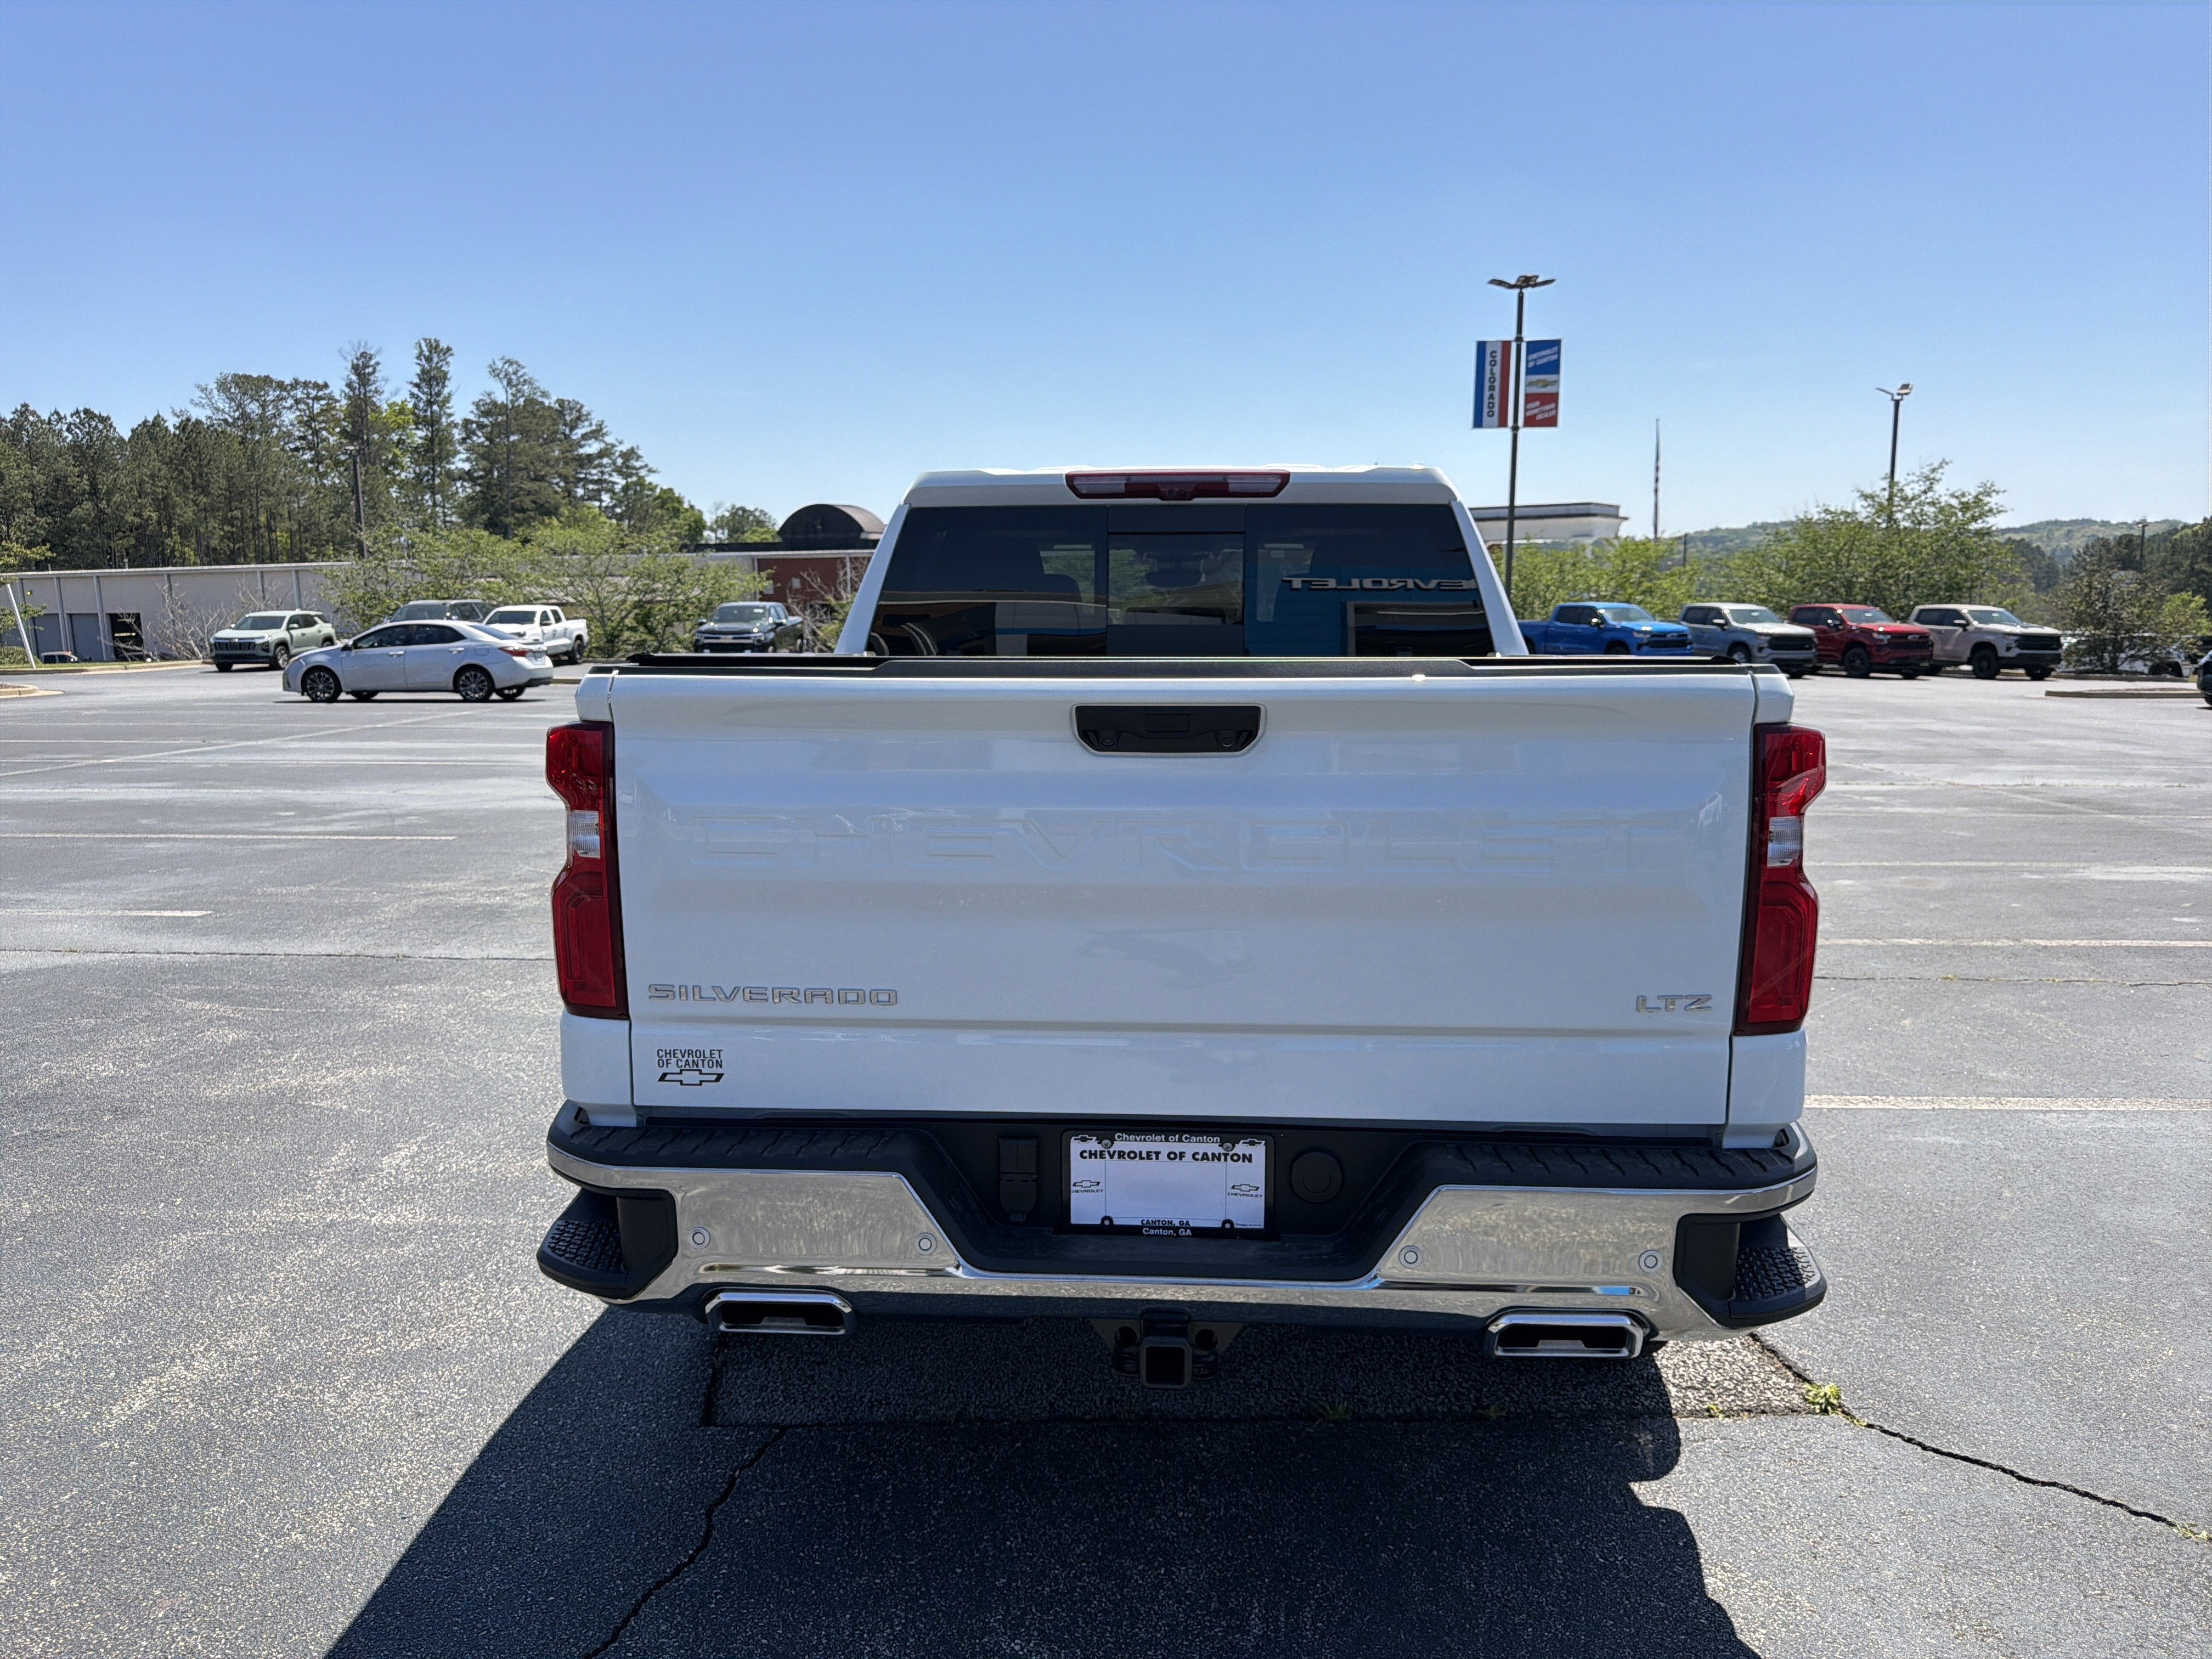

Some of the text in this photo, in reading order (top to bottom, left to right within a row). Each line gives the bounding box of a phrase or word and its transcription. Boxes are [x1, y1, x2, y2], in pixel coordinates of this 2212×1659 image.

[1487, 350, 1497, 417] COLORADO
[687, 815, 1672, 871] CHEVROLET
[648, 983, 898, 1006] SILVERADO
[1636, 994, 1712, 1012] LTZ
[657, 1048, 724, 1059] CHEVROLET
[657, 1058, 723, 1069] OF CANTON
[1114, 1132, 1221, 1143] Chevrolet of Canton
[1079, 1149, 1253, 1163] CHEVROLET OF CANTON
[1140, 1219, 1176, 1227] CANTON,
[1142, 1228, 1177, 1237] Canton,
